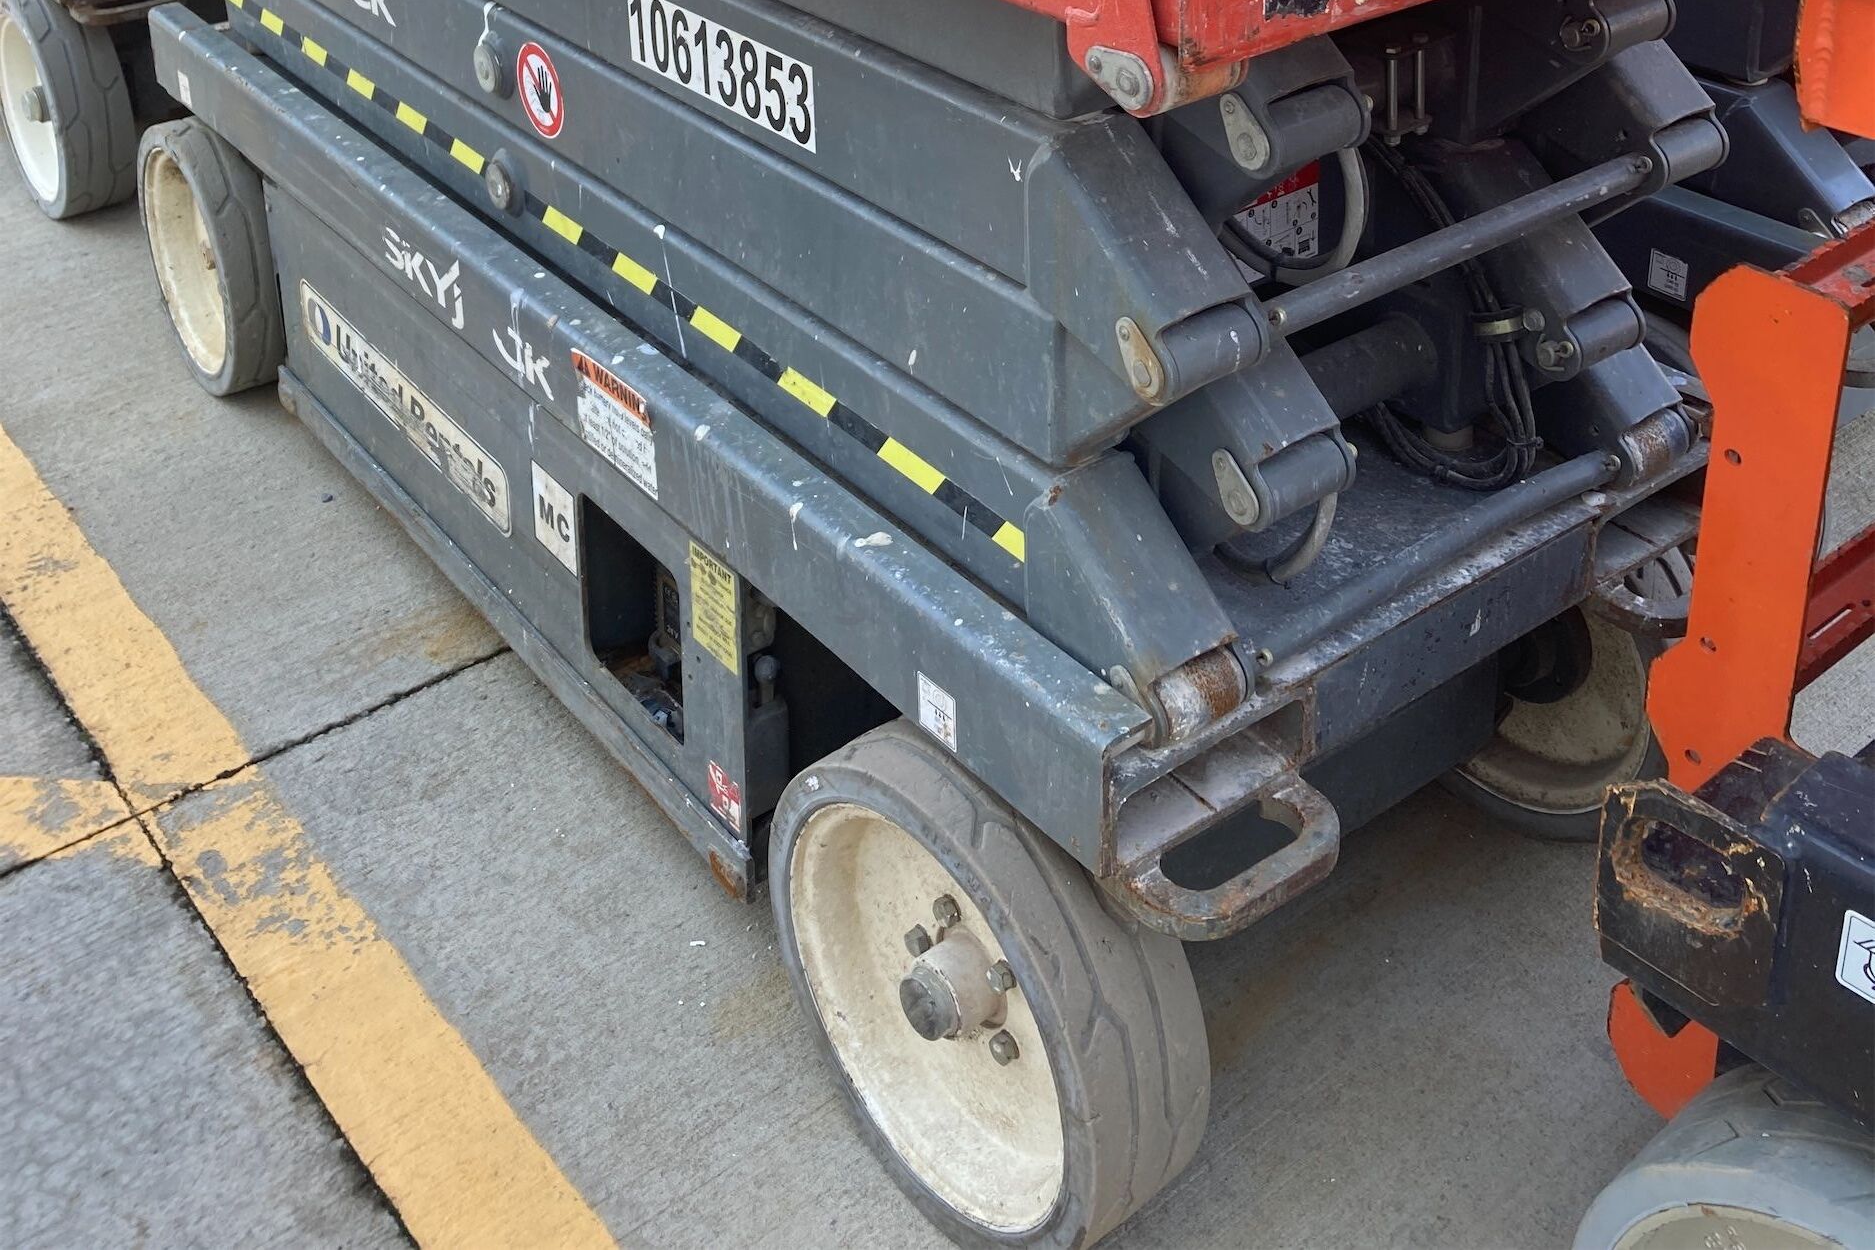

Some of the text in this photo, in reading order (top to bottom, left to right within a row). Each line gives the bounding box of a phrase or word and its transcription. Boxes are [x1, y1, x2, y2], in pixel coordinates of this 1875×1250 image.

[382, 226, 554, 401] SKYJCK
[539, 494, 571, 544] MC
[692, 545, 732, 586] IMPORTANT
